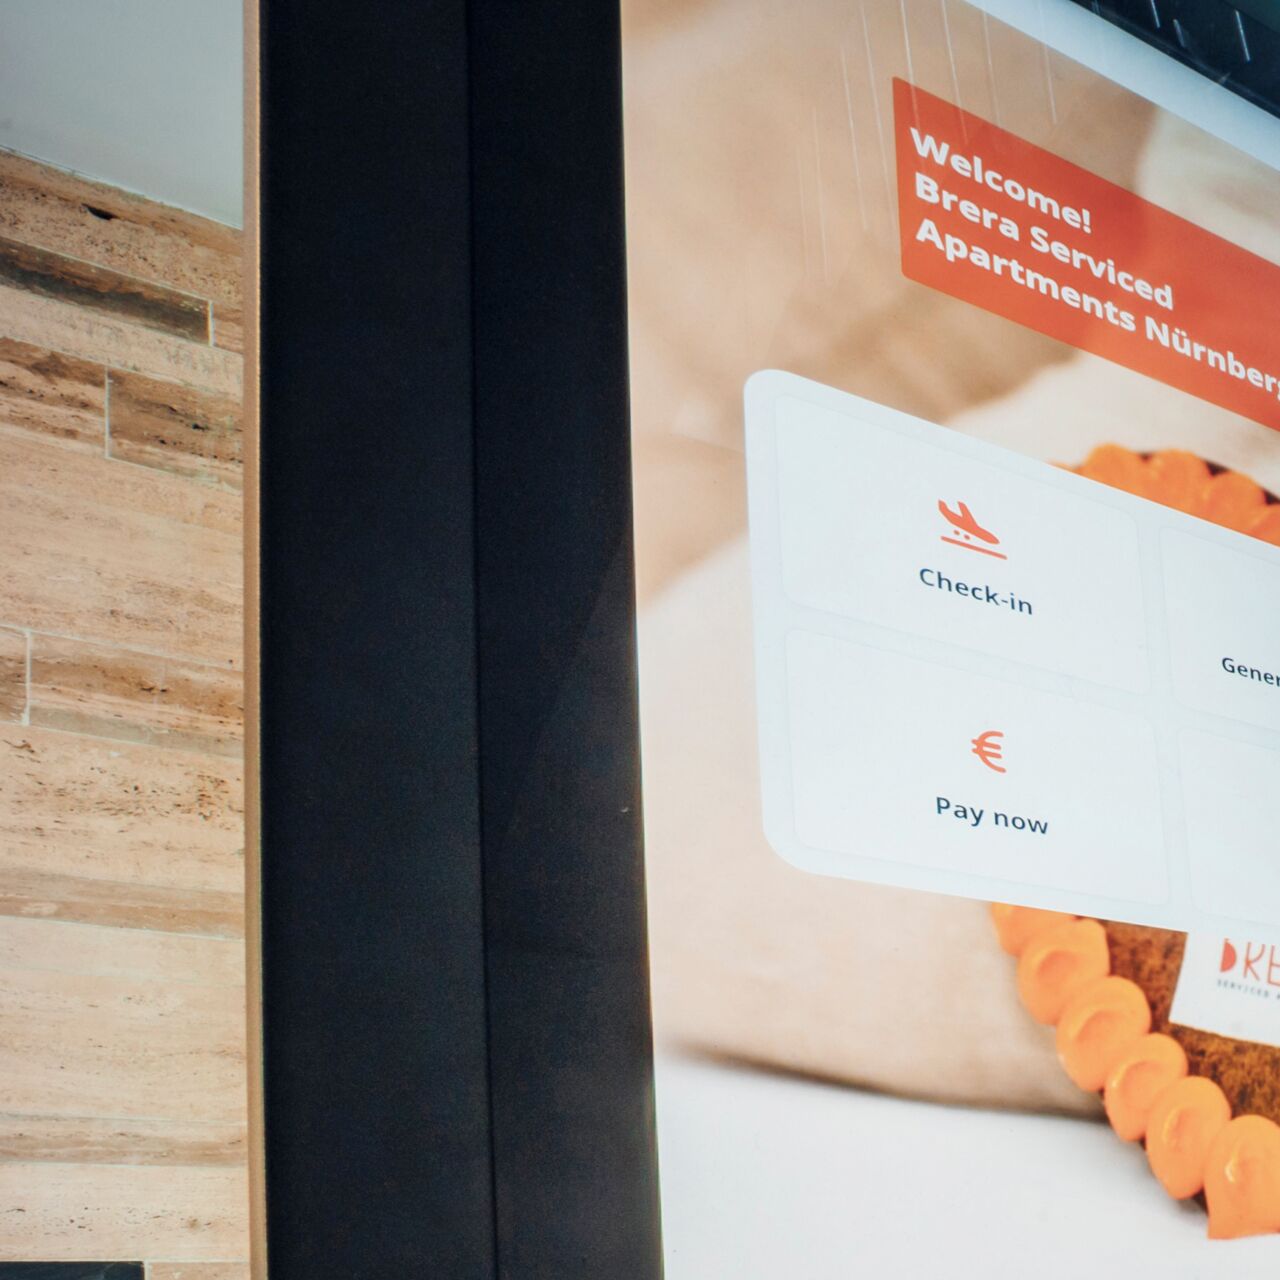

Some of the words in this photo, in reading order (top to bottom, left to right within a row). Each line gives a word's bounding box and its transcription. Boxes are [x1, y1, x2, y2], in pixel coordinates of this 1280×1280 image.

[910, 127, 1092, 235] Welcome!
[915, 172, 1020, 241] Brera
[1030, 226, 1173, 311] Serviced
[915, 219, 1136, 331] Apartments
[919, 567, 1034, 616] Check-in
[935, 797, 985, 828] Pay
[993, 808, 1049, 836] now
